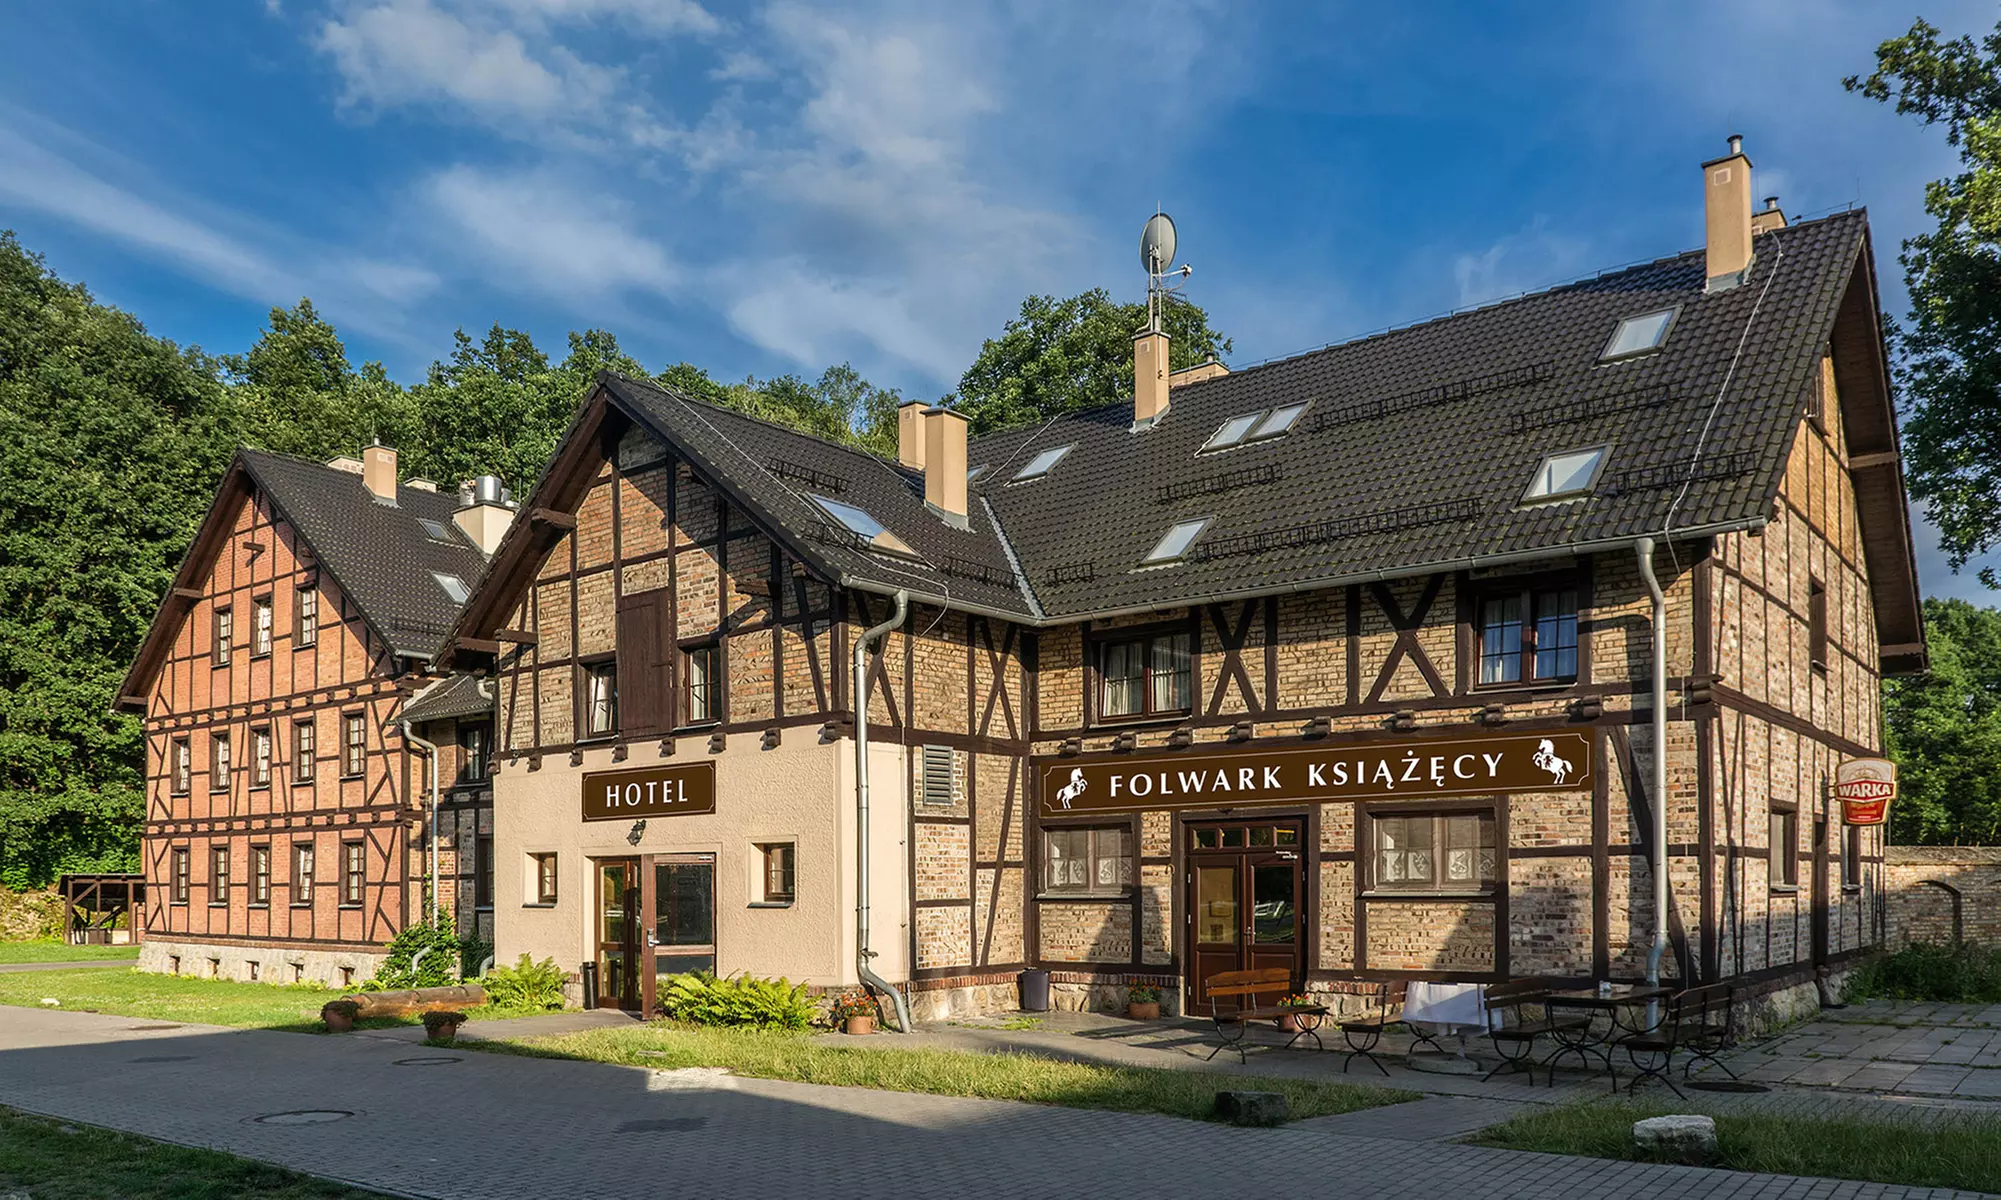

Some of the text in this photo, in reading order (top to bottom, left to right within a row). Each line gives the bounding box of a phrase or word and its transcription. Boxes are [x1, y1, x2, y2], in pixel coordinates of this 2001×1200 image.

[1110, 750, 1504, 797] FOLWARK KSIĄŻĘCY
[606, 779, 688, 807] HOTEL
[1838, 783, 1891, 797] WARKA
